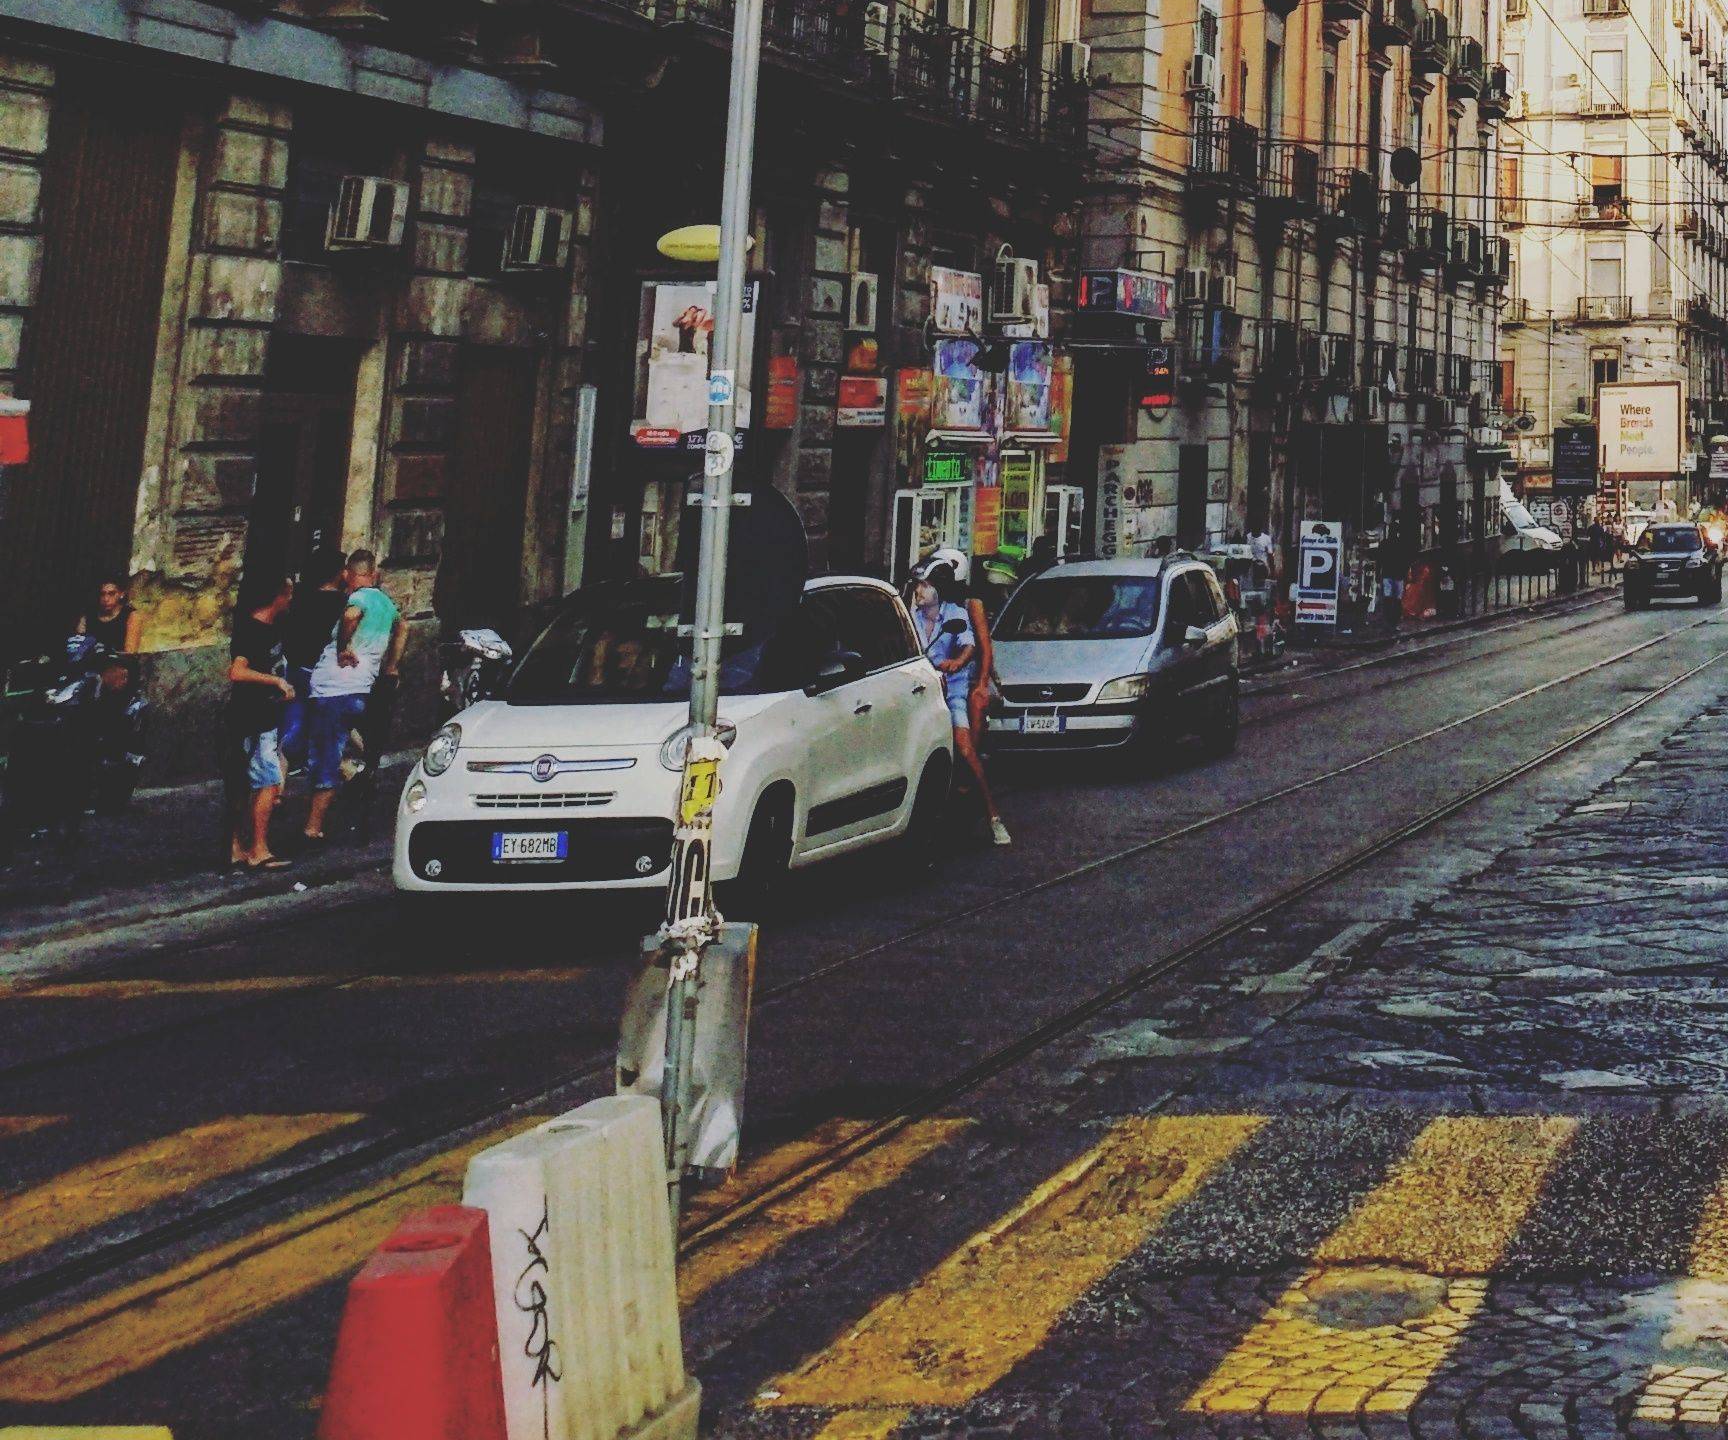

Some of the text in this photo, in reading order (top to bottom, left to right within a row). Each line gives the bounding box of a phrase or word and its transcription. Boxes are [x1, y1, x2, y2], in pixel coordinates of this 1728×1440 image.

[1620, 403, 1651, 415] Where
[1302, 550, 1333, 587] P
[503, 837, 557, 854] EY 682MB
